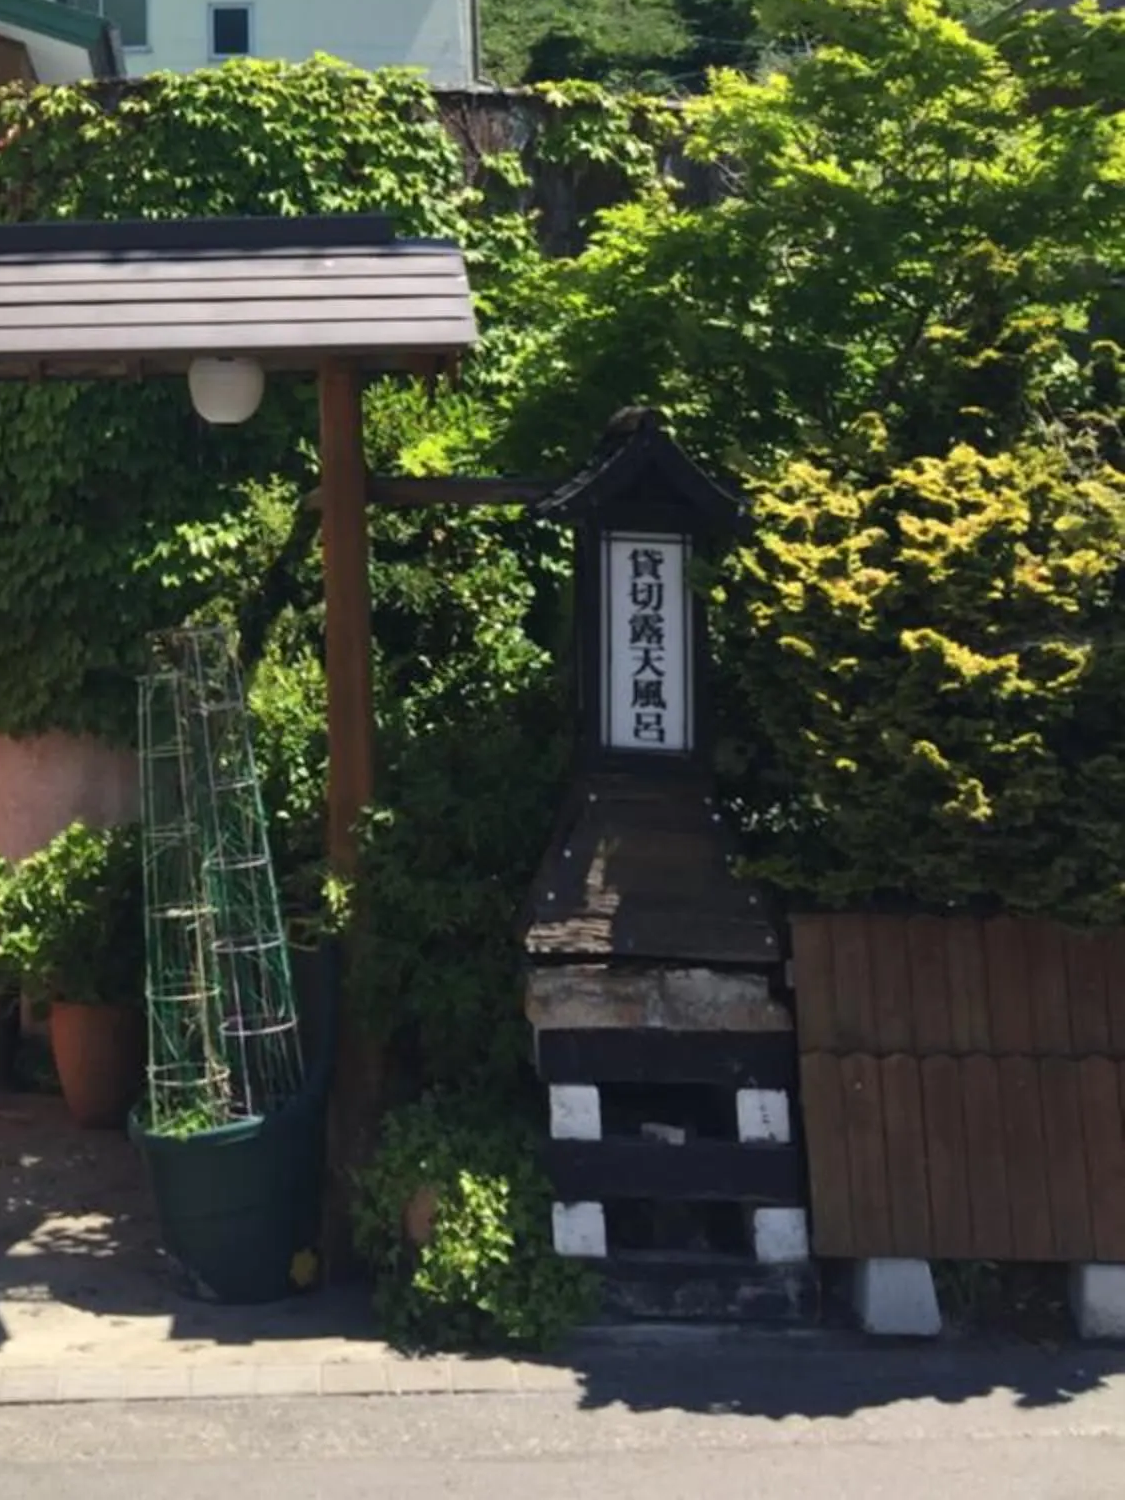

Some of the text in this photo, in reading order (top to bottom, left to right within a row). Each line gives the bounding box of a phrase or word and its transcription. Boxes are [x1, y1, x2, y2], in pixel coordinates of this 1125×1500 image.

[627, 547, 667, 745] 貸切露天風呂
